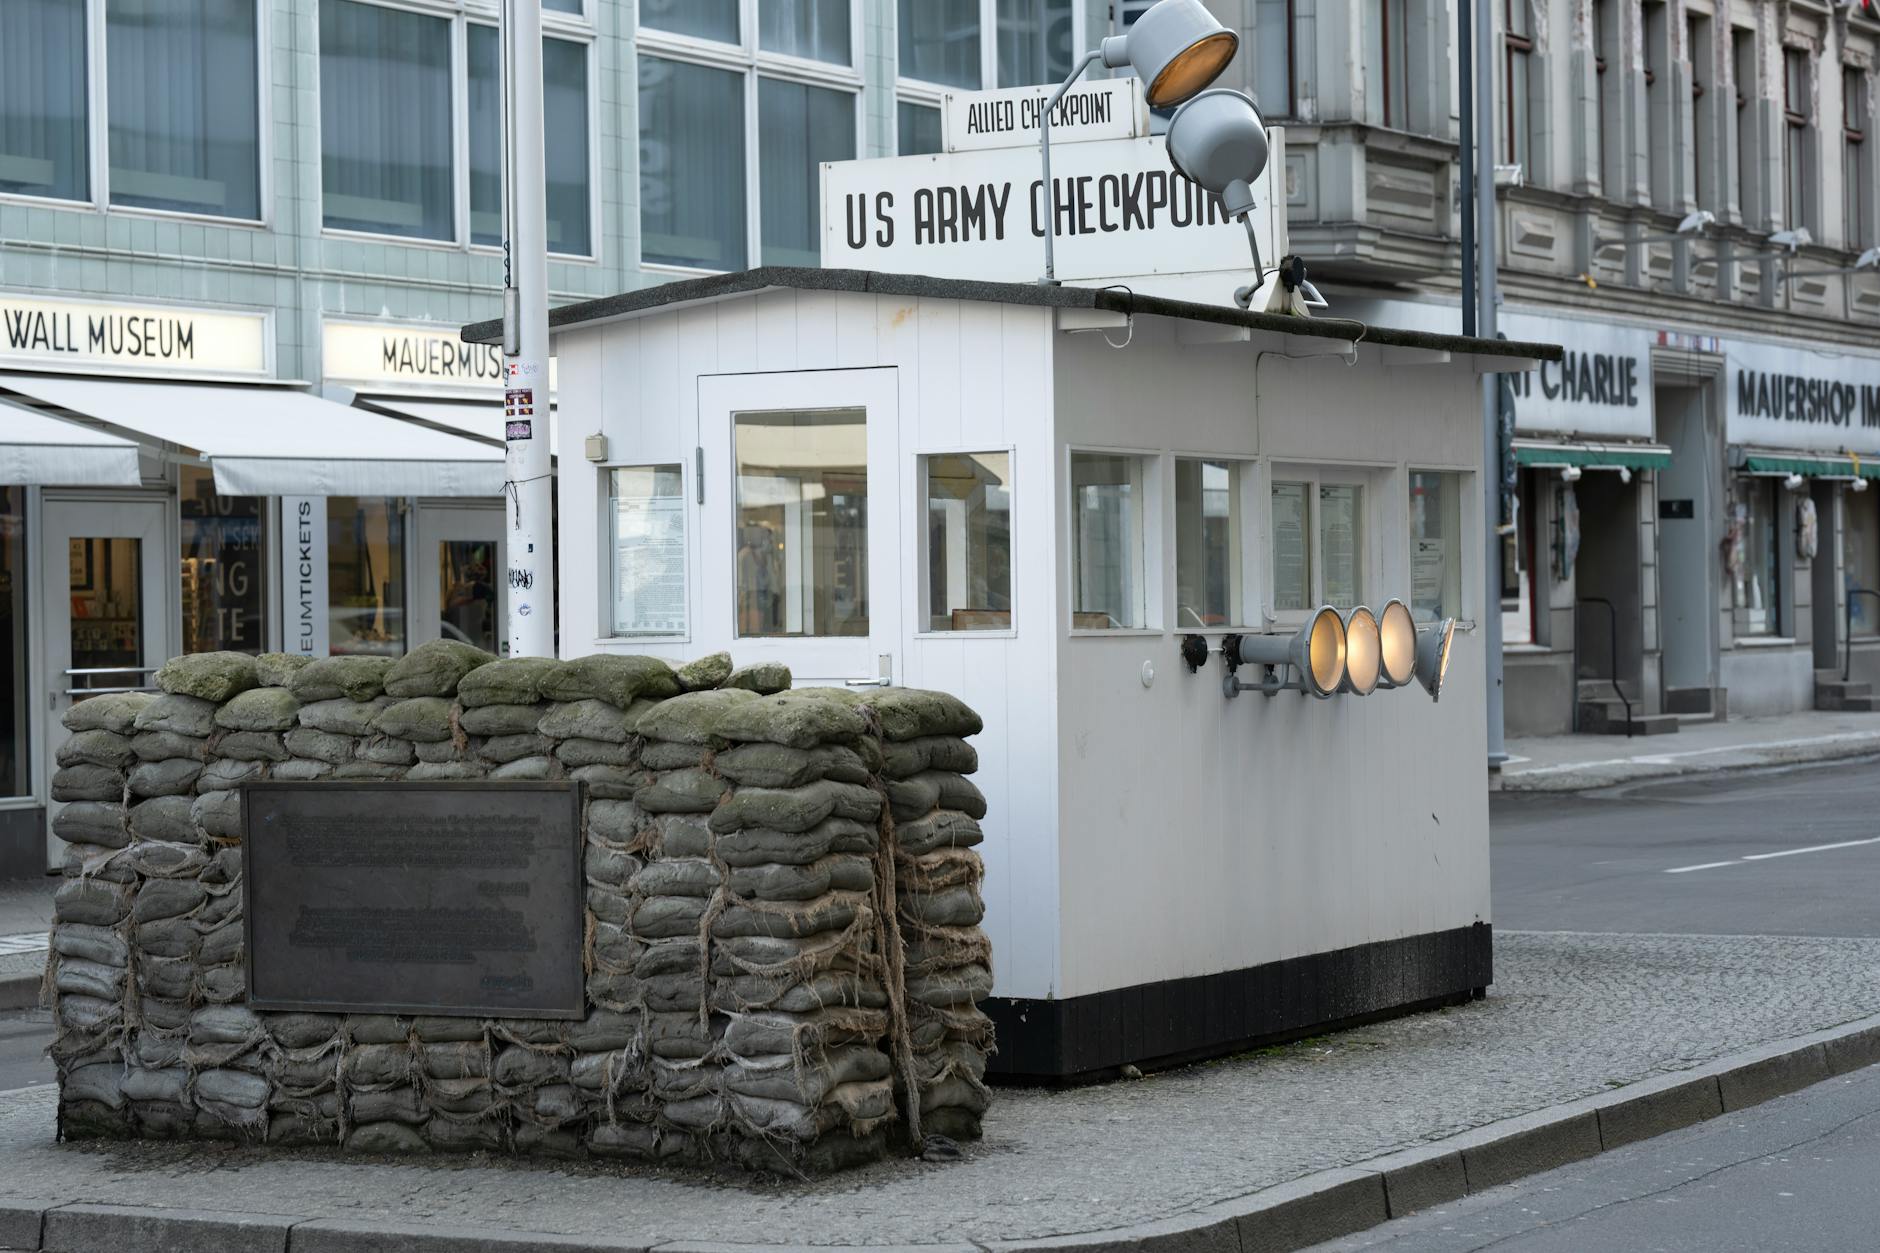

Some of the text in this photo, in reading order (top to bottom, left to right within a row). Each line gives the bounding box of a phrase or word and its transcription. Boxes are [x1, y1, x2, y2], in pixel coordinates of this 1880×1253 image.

[968, 100, 1014, 134] ALLIED
[914, 182, 1011, 245] ARMY
[1030, 170, 1244, 238] CHECKPOIN
[4, 309, 194, 360] WALL MUSEUM
[383, 337, 505, 379] MAUERMUS
[1540, 350, 1638, 407] CHARLIE
[1737, 369, 1856, 427] MAUERSHOP
[299, 501, 313, 657] EUMTICKETS
